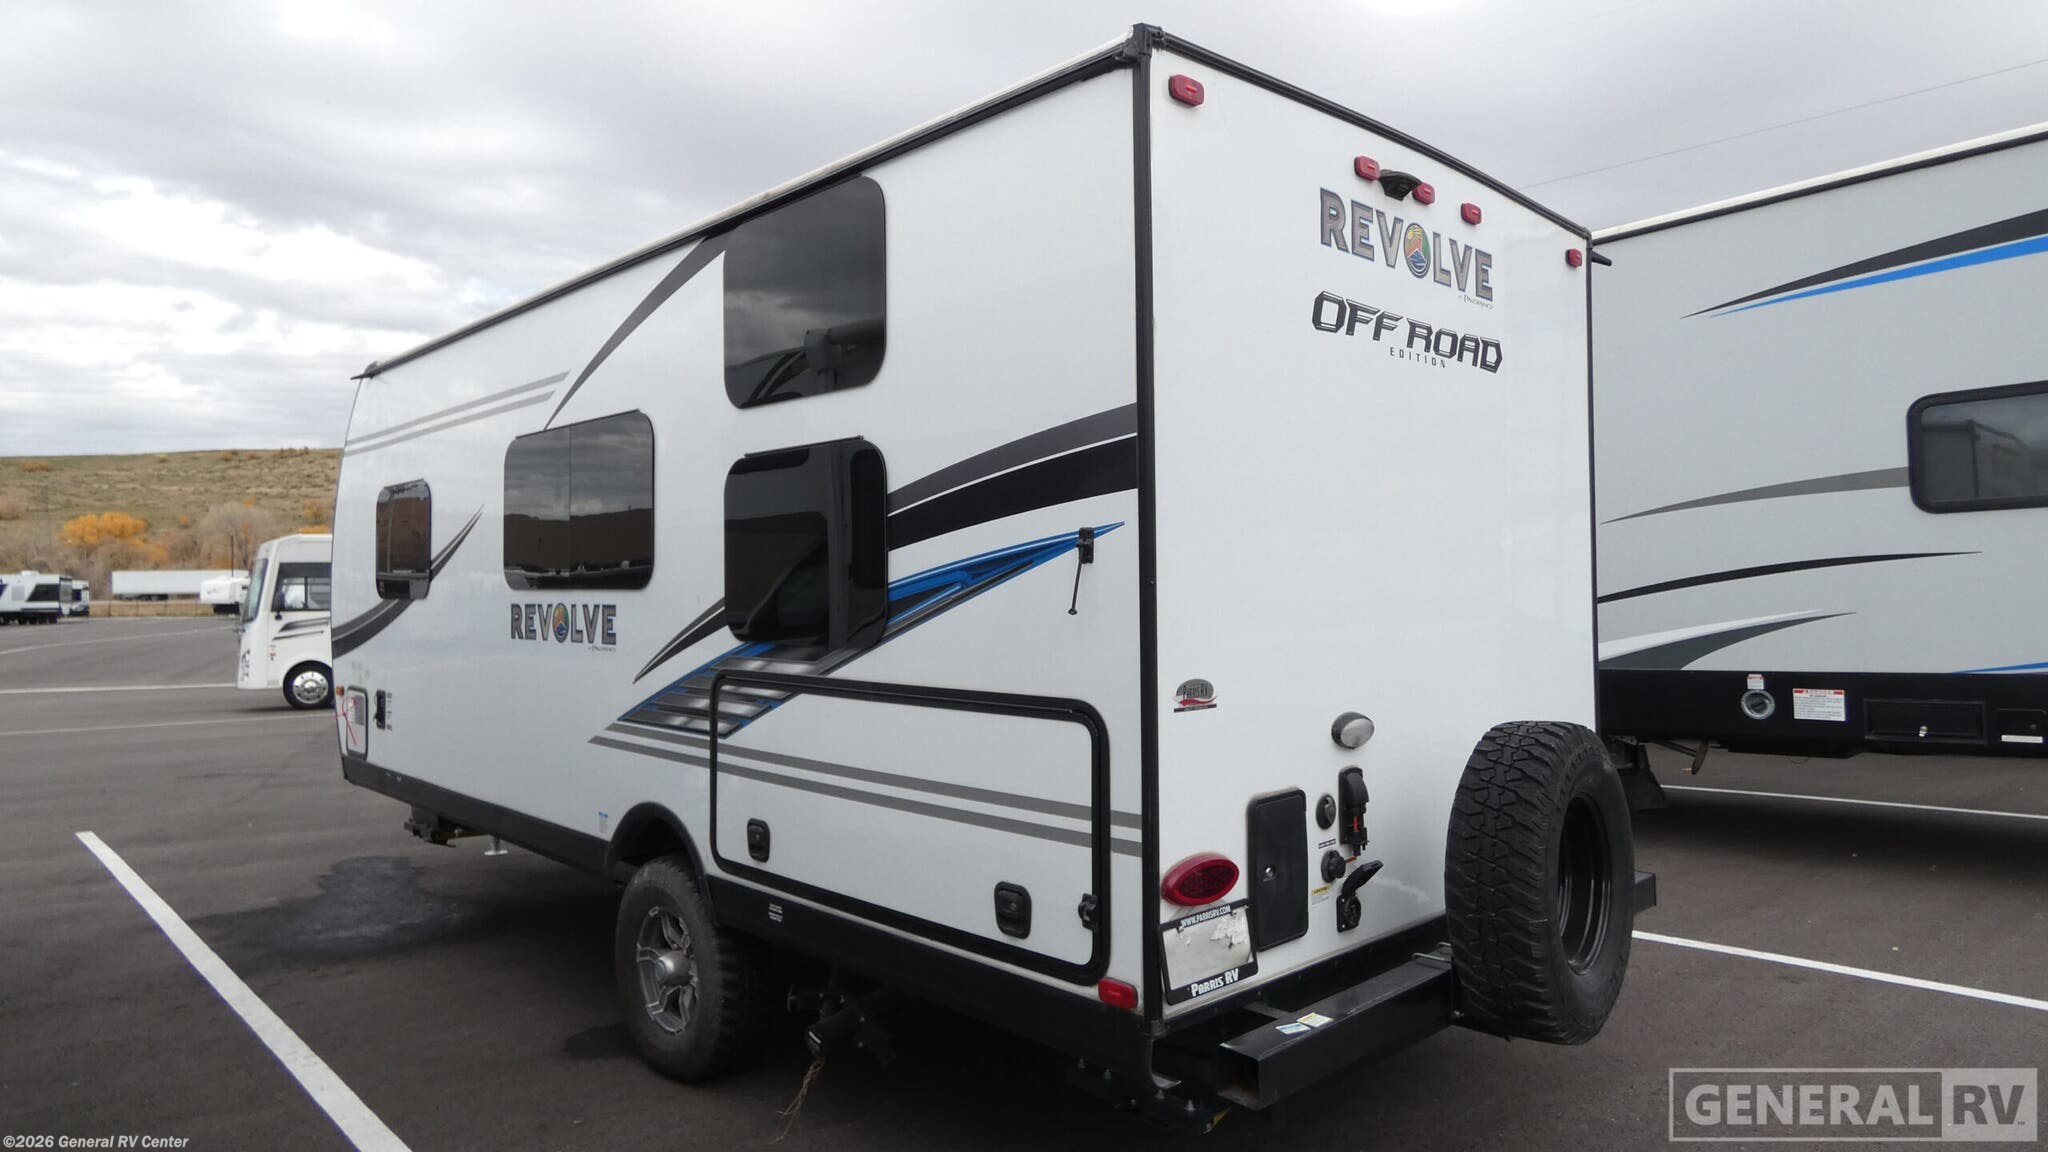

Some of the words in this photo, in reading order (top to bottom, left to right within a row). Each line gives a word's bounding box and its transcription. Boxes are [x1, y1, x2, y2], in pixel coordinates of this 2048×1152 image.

[1320, 187, 1493, 302] REVOLVE
[1312, 290, 1404, 342] OFF
[1406, 317, 1503, 374] ROAD
[1389, 346, 1446, 369] EDITION
[510, 602, 617, 646] REVOLVE
[1224, 968, 1239, 985] RV
